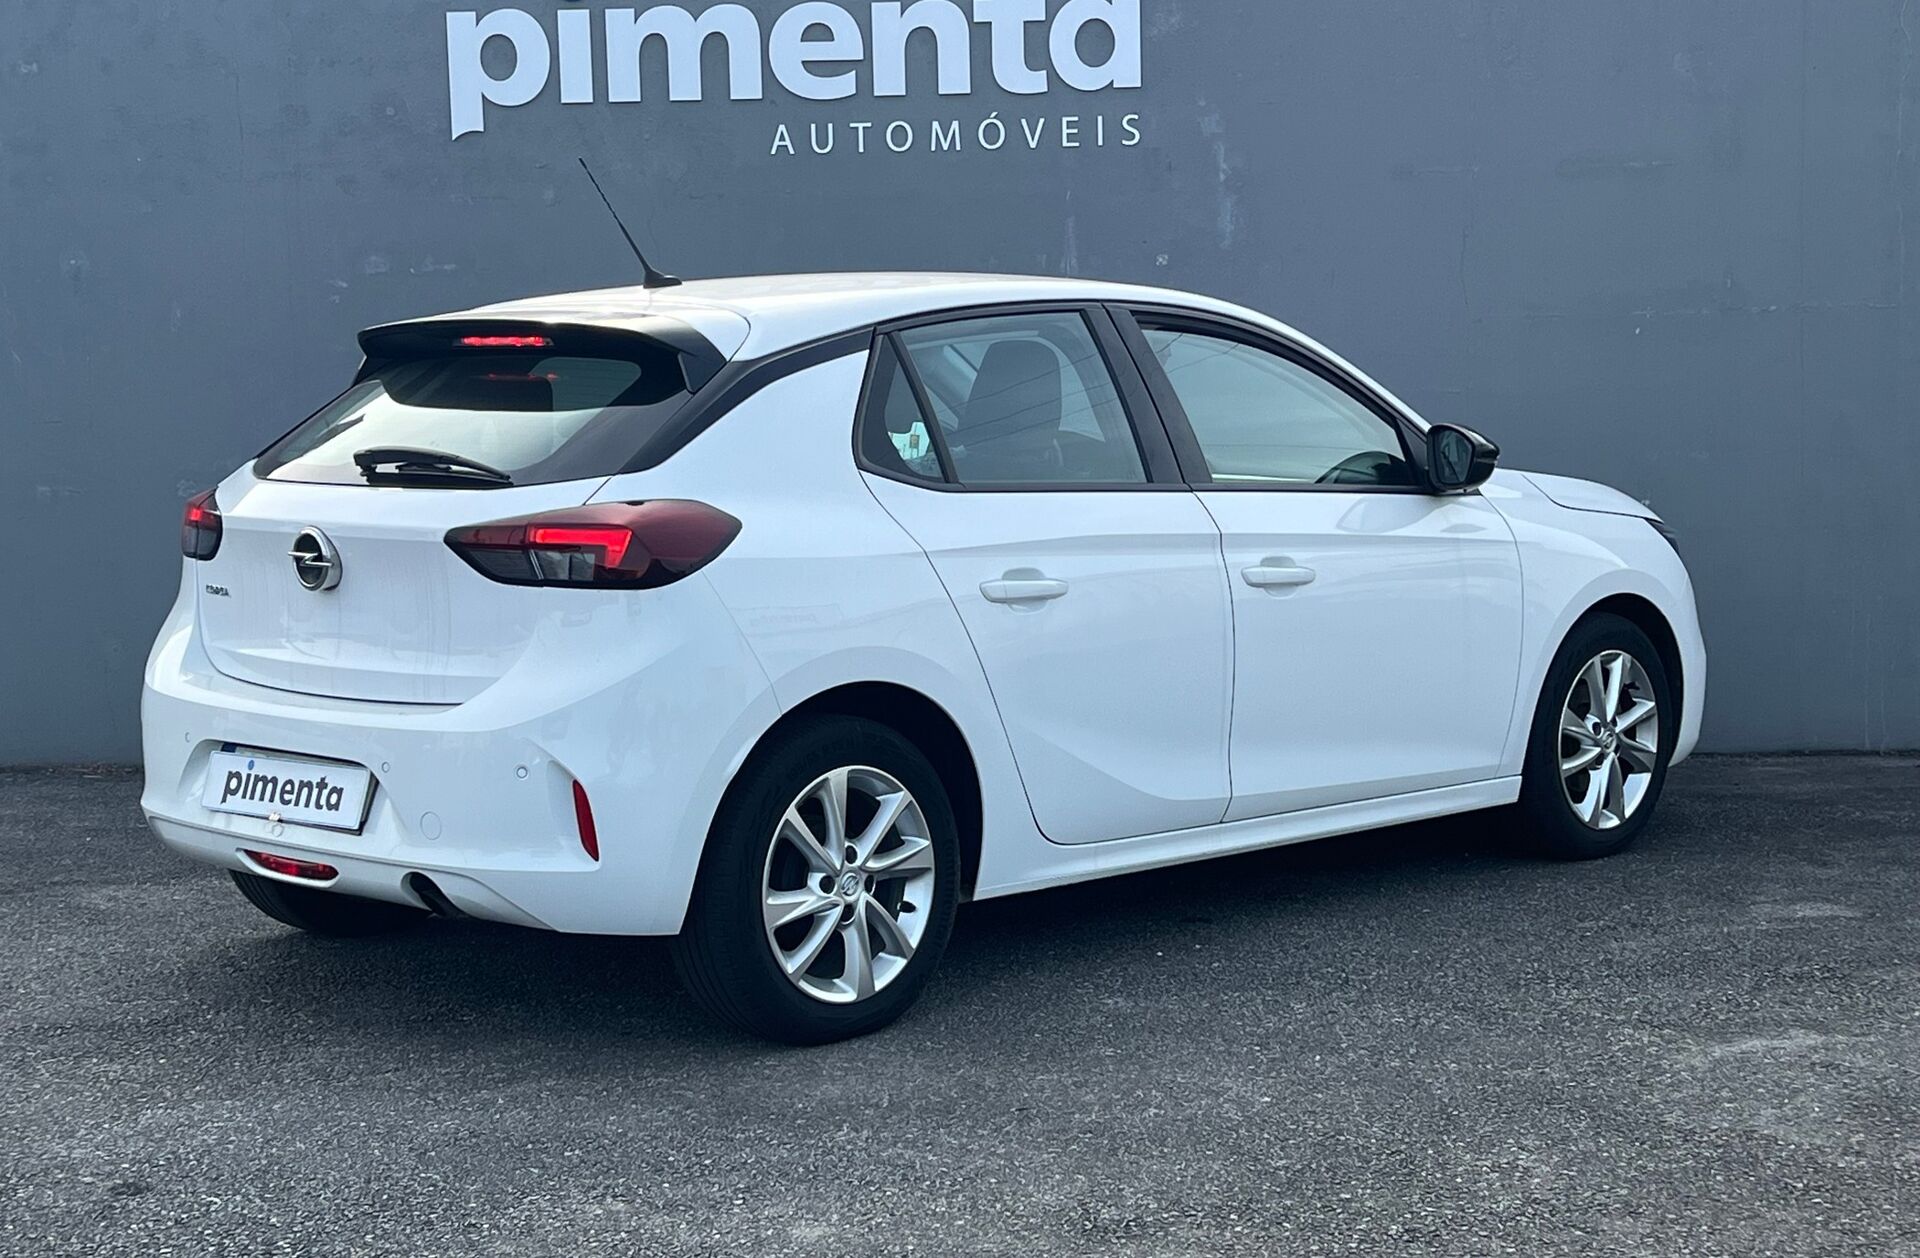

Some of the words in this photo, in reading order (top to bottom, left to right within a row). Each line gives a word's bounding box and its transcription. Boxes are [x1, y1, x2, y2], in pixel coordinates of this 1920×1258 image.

[446, 0, 1142, 141] pimenta
[770, 112, 1142, 155] AUTOMÓVEIS
[220, 759, 345, 812] pimenta
